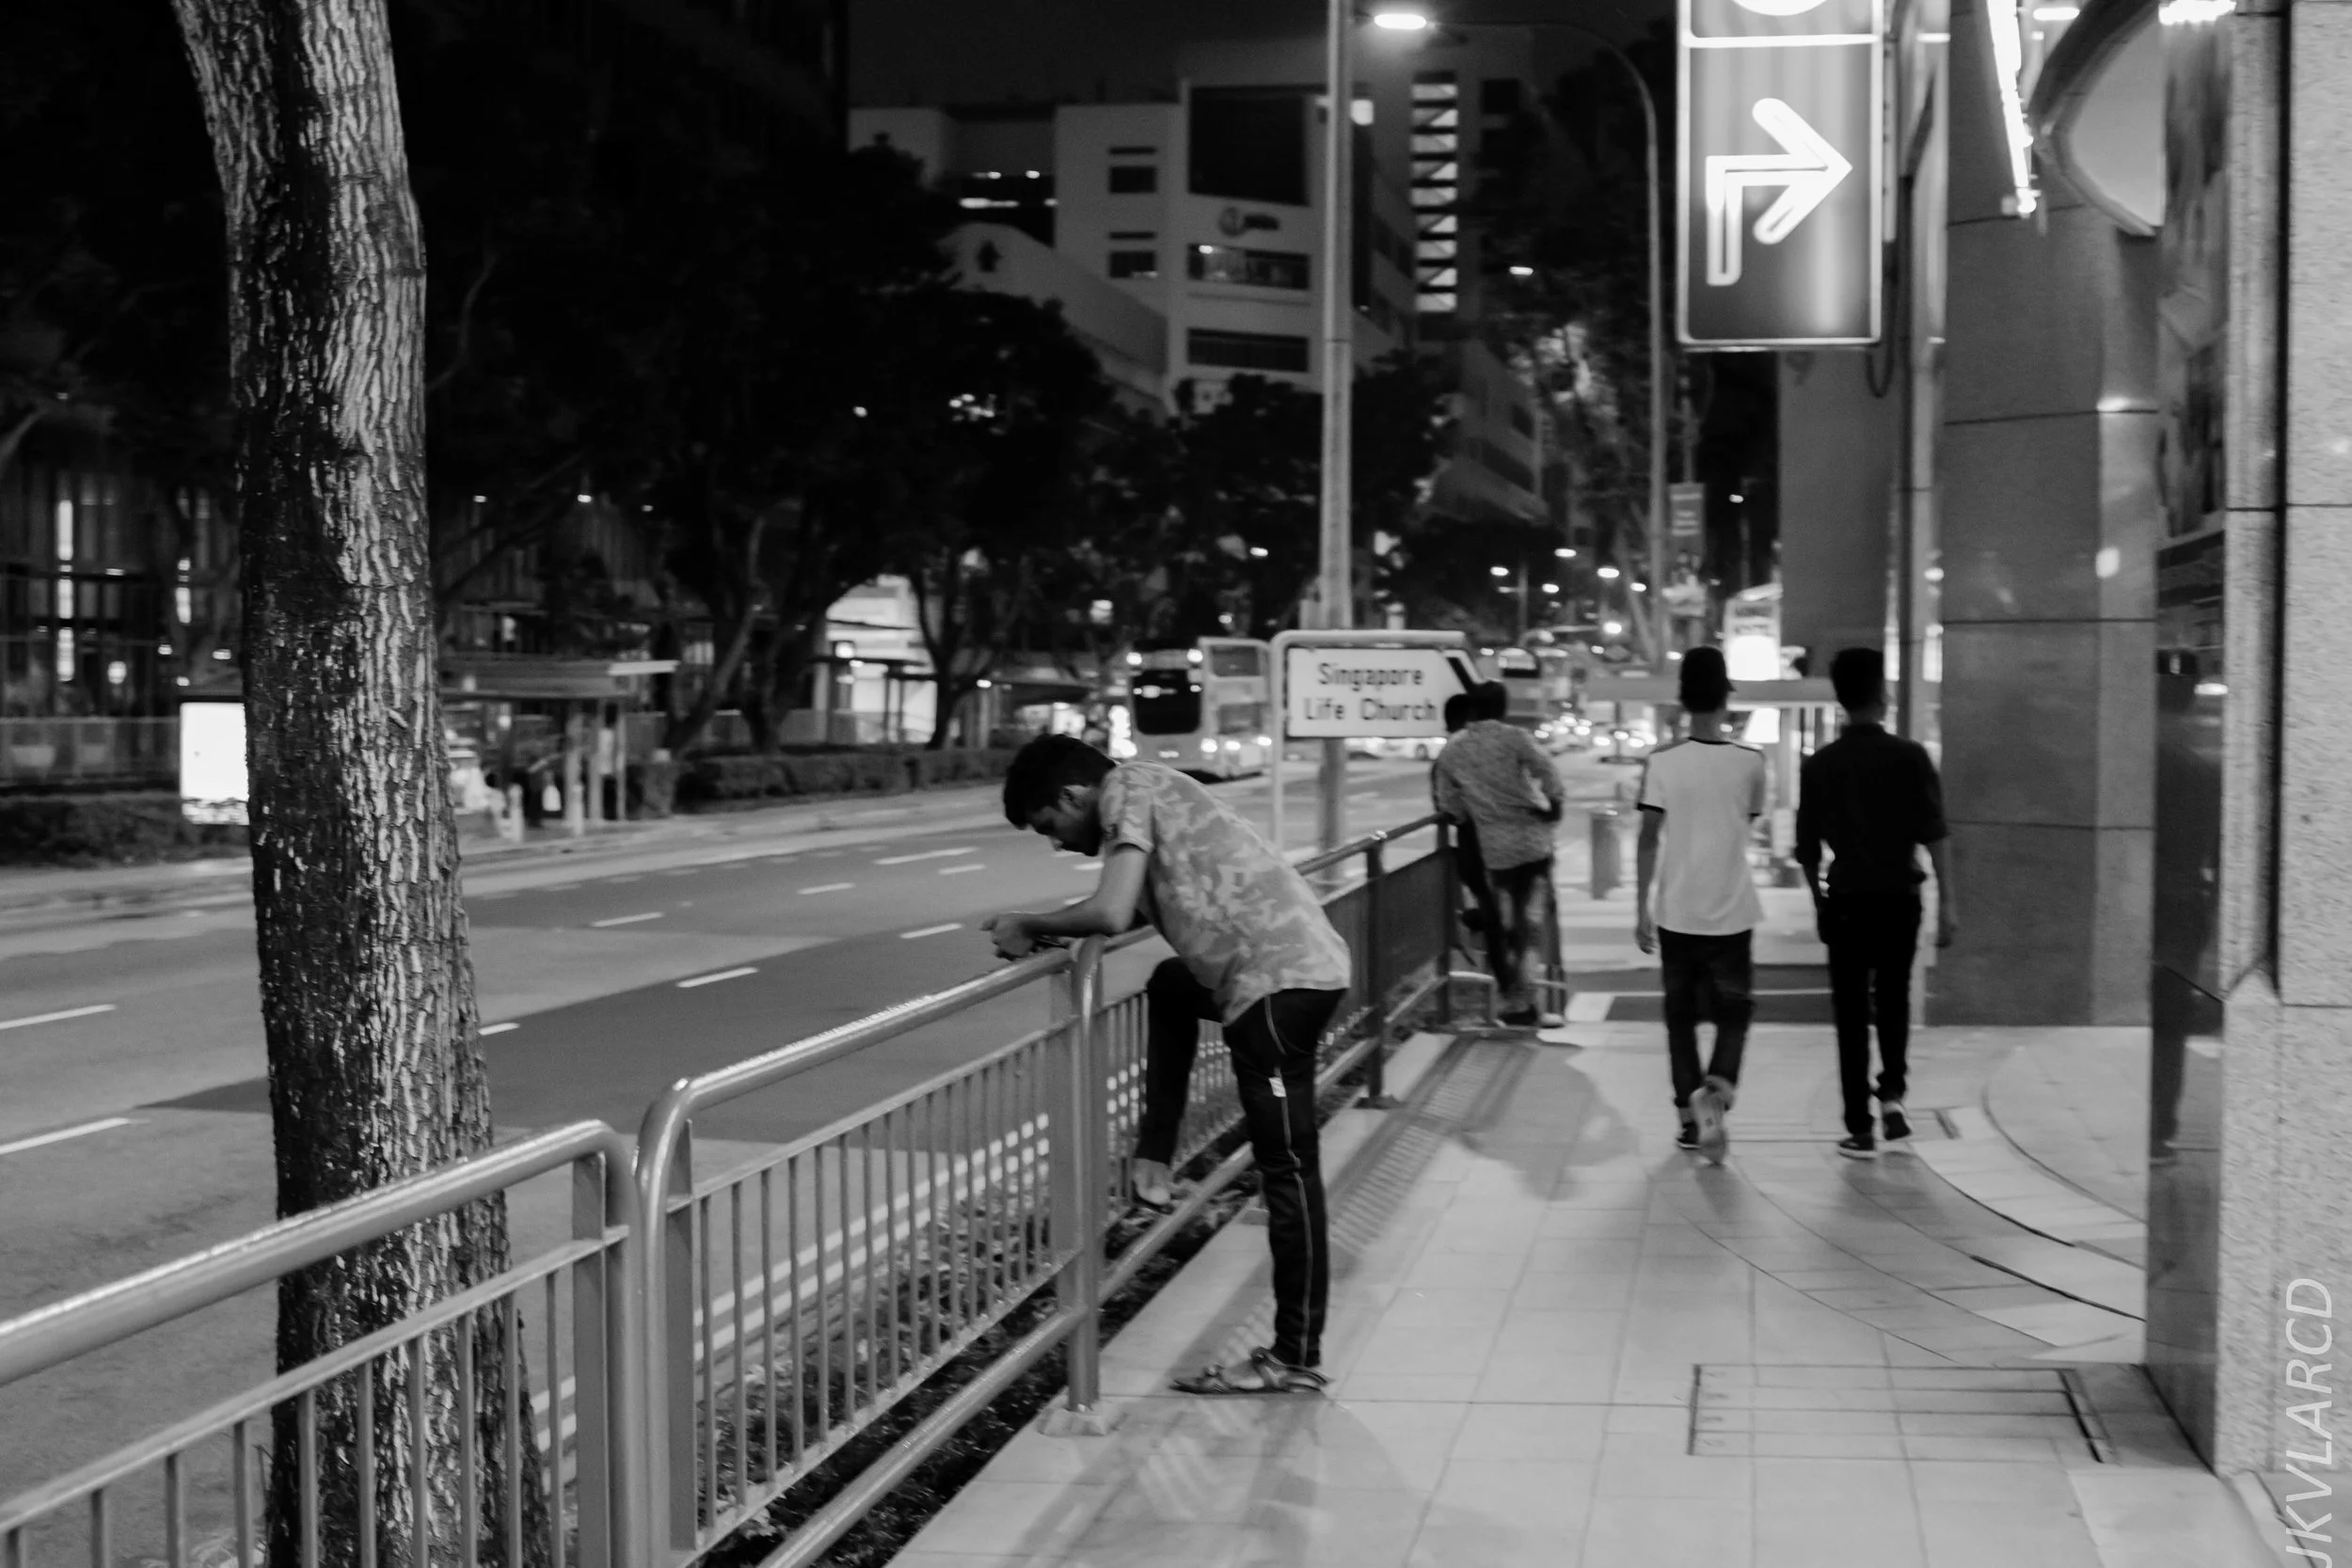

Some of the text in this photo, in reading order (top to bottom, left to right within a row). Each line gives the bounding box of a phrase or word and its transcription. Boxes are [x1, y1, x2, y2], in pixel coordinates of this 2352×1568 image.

[1318, 662, 1423, 691] Singapore
[1303, 697, 1438, 721] Life Church
